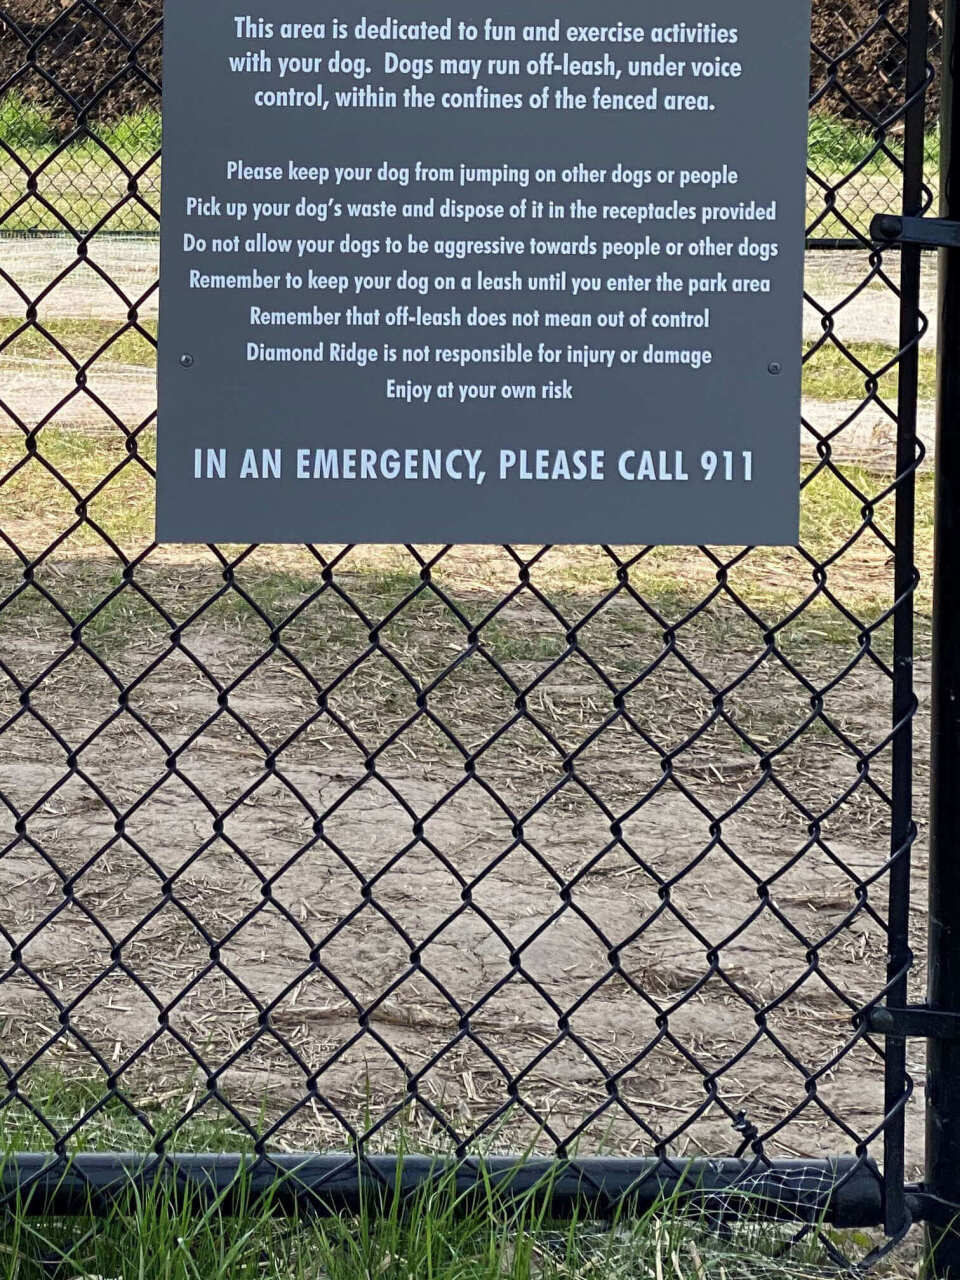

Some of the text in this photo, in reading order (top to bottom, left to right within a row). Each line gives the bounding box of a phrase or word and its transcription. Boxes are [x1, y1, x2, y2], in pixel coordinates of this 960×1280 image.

[234, 15, 738, 43] This area is dedicated to fun and exercise activities
[229, 49, 742, 80] with your dog. Dogs may run off-leash, under voice
[254, 84, 715, 110] control, within the confines of the fenced area.
[227, 160, 738, 188] Please keep your dog from jumping on other dogs or people
[187, 196, 776, 224] Pick up your dog's waste and dispose of it in the receptacles provided
[183, 233, 778, 261] Do not allow your dogs to be aggressive towards people or other dogs
[190, 269, 770, 296] Remember to keep your dog on a leash until you enter the park area
[250, 305, 709, 328] Remember that off-leash does not mean out of control
[247, 342, 712, 369] Diamond Ridge is not responsible for injury or damage
[387, 379, 573, 403] Enjoy at your own risk
[194, 448, 752, 485] IN AN EMERGENCY, PLEASE CALL 911
